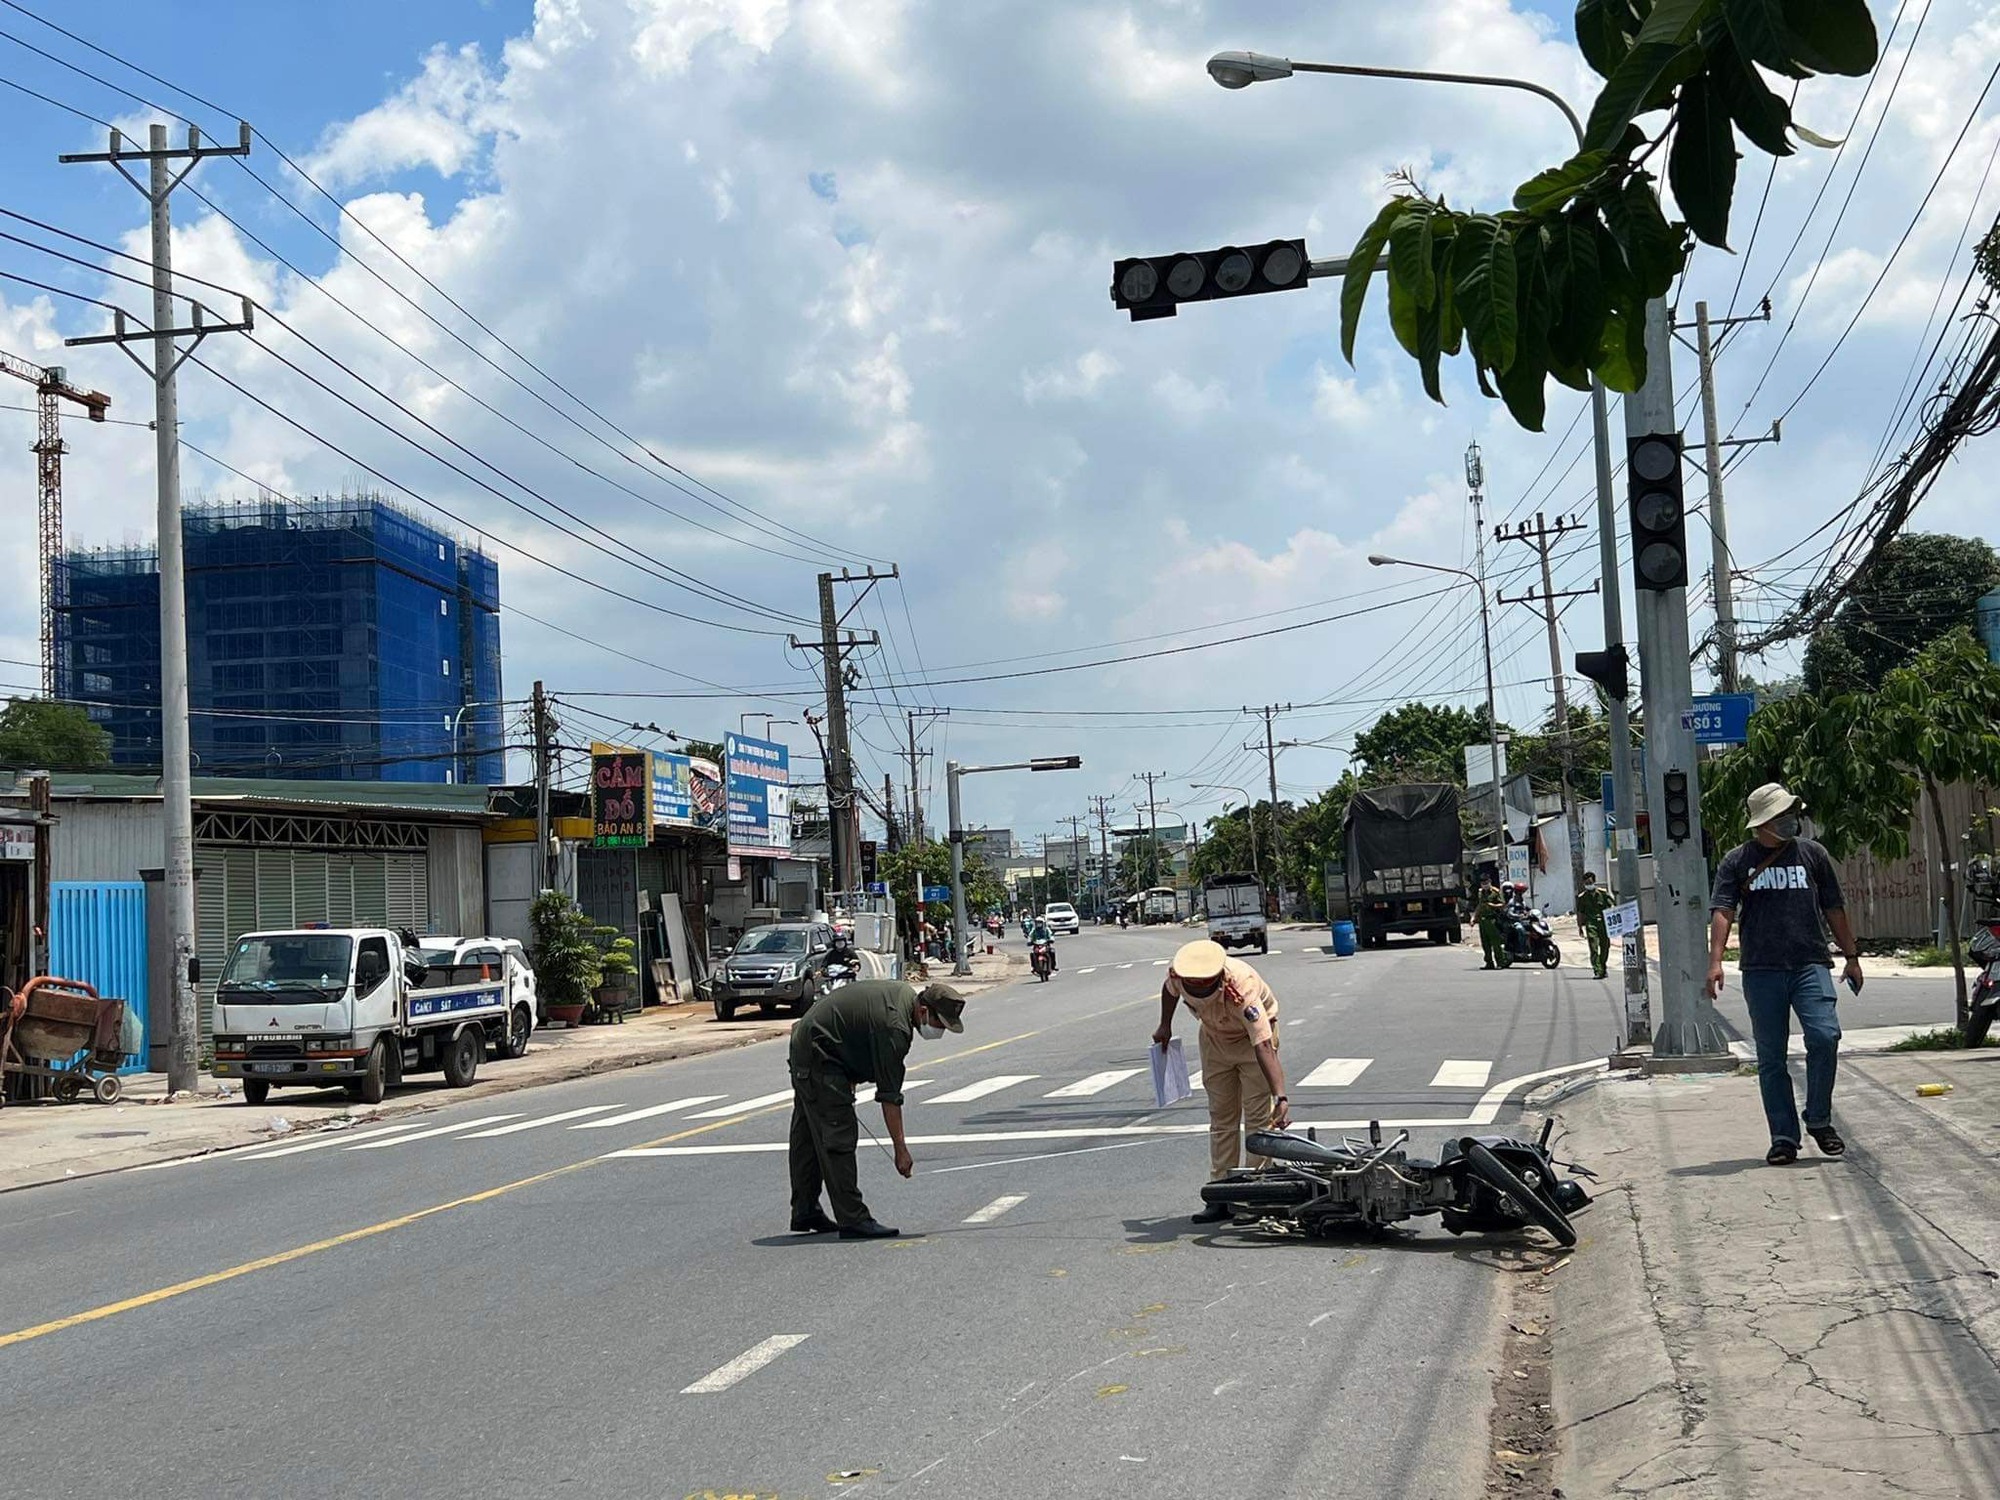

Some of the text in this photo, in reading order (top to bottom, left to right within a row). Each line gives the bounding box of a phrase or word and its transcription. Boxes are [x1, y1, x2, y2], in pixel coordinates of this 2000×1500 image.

[1693, 712, 1722, 730] SỐ 3
[620, 822, 634, 835] AN
[1626, 944, 1636, 956] N
[246, 1034, 303, 1042] MITSUBISHI
